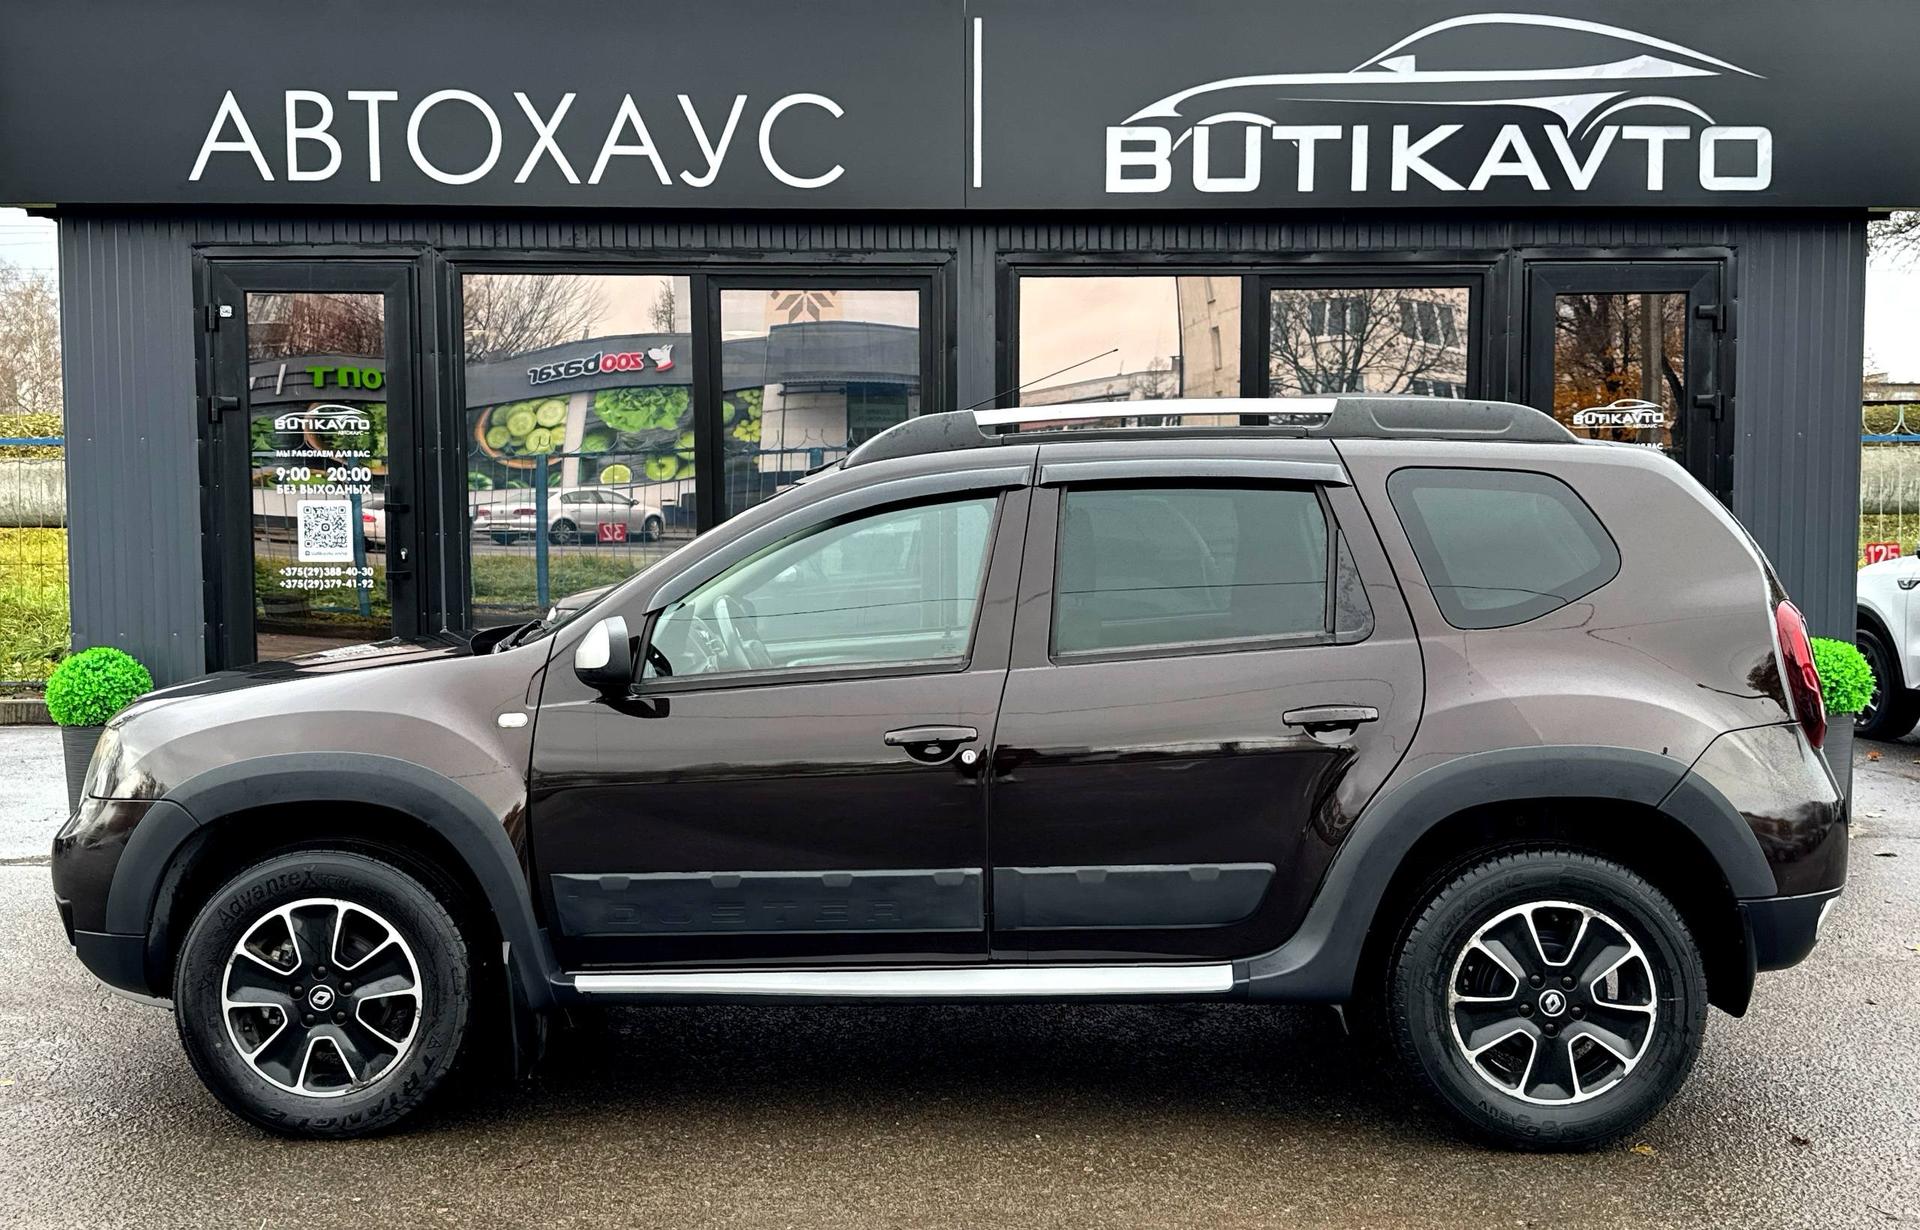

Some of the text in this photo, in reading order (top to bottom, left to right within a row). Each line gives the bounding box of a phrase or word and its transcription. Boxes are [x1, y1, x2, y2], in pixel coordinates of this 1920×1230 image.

[188, 89, 845, 188] АВТОХАУС
[1105, 124, 1772, 193] BUTIKAVTO
[274, 419, 370, 430] BUTIKAVTO
[1573, 413, 1665, 425] BUTIKAVTO
[276, 450, 371, 459] МЫ РАБОТАЕМ ДЛЯ ВАС
[276, 466, 311, 481] 9:00
[327, 466, 372, 481] 20:00
[276, 484, 372, 495] БЕЗ ВЫХОДНЫХ
[606, 902, 902, 926] DUSTER
